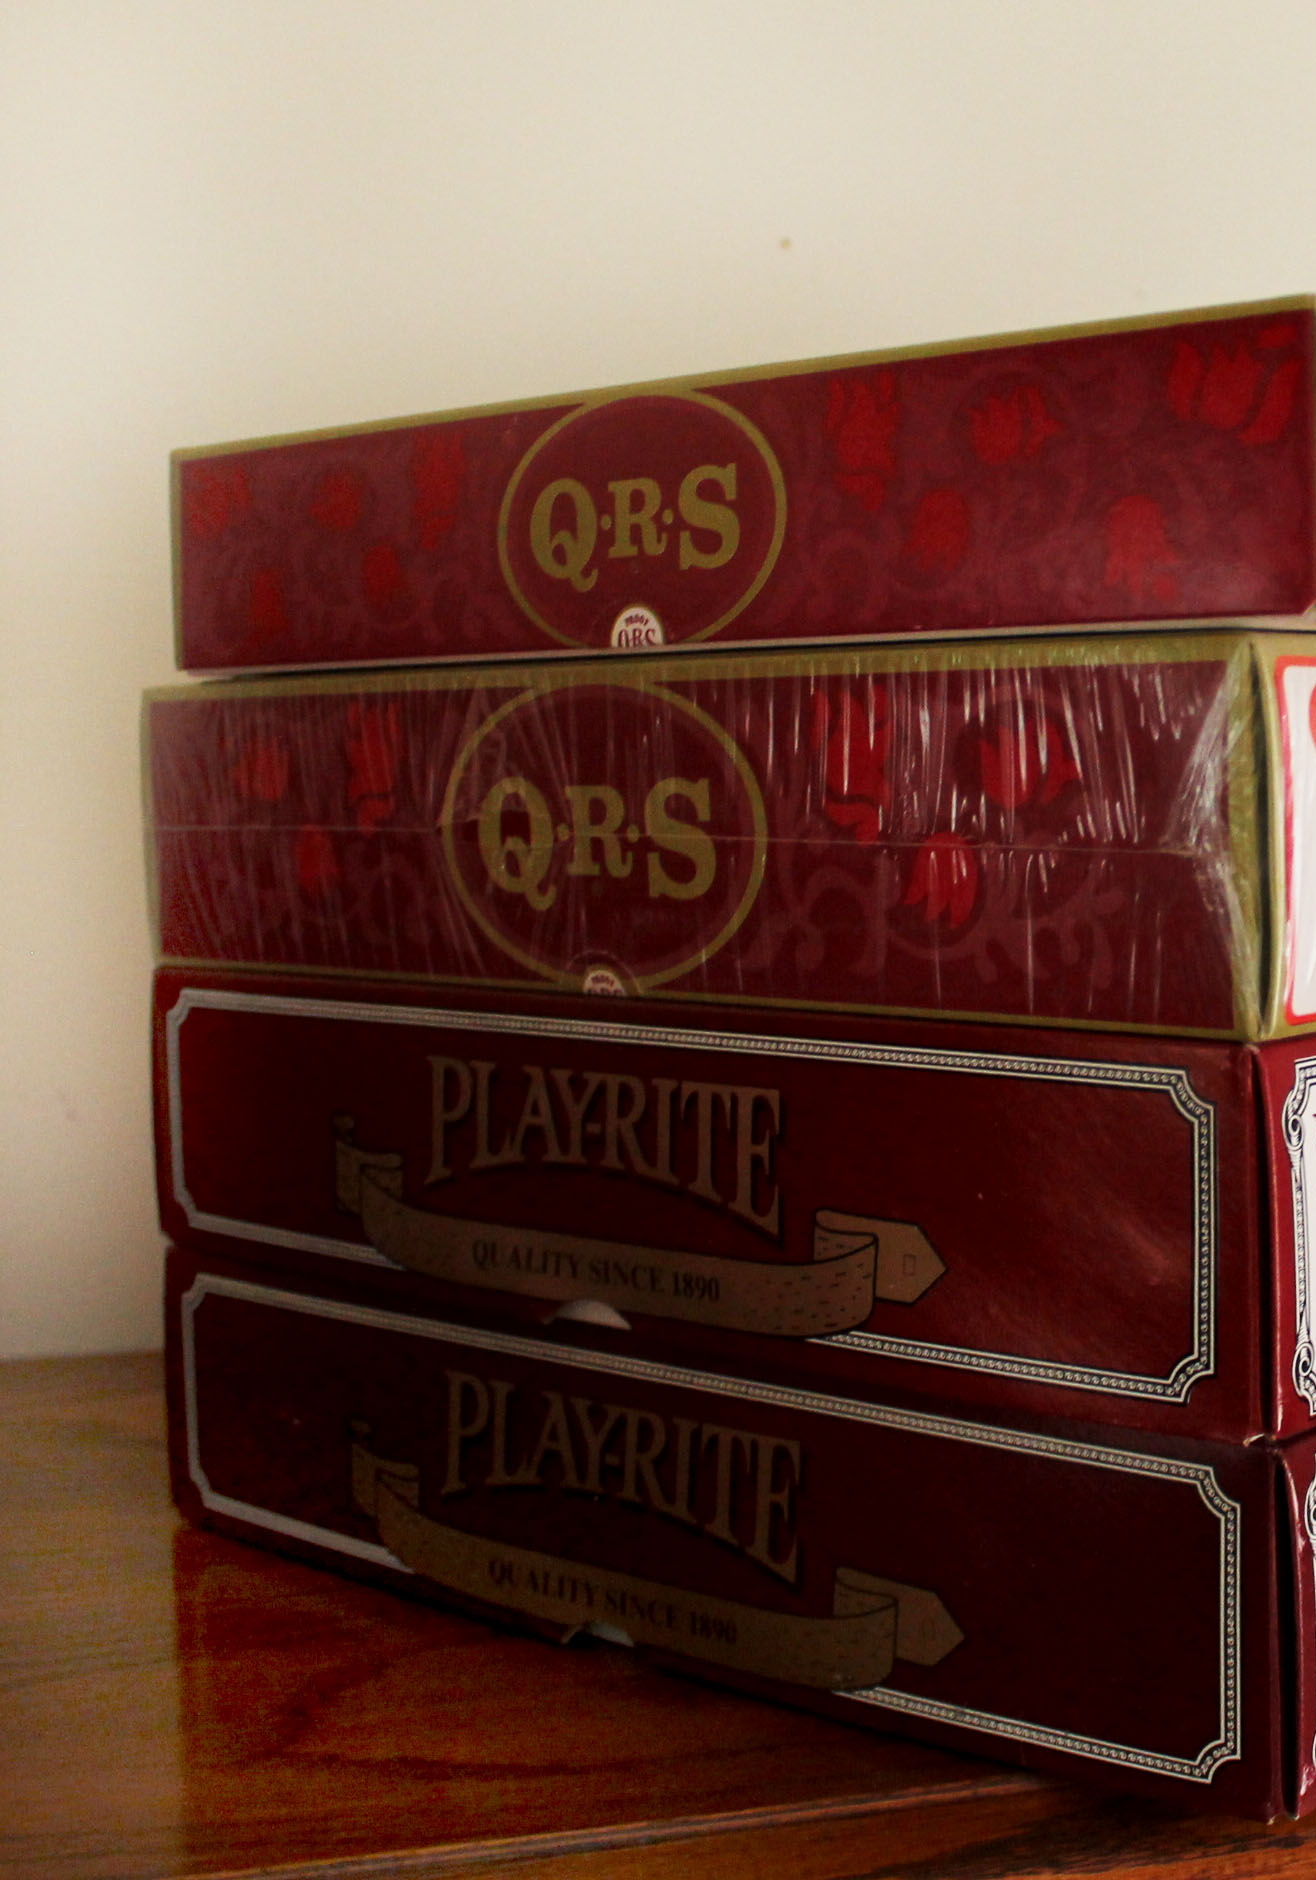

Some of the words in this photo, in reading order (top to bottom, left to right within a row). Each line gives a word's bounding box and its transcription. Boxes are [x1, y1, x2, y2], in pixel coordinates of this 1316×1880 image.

[424, 1055, 782, 1242] PLAY-RITE
[471, 1238, 580, 1278] QUALITY
[587, 1260, 664, 1295] SINCE
[672, 1268, 721, 1300] 1890
[487, 1557, 596, 1603] QUALITY
[602, 1588, 679, 1631] SINCE
[688, 1607, 738, 1644] 1890
